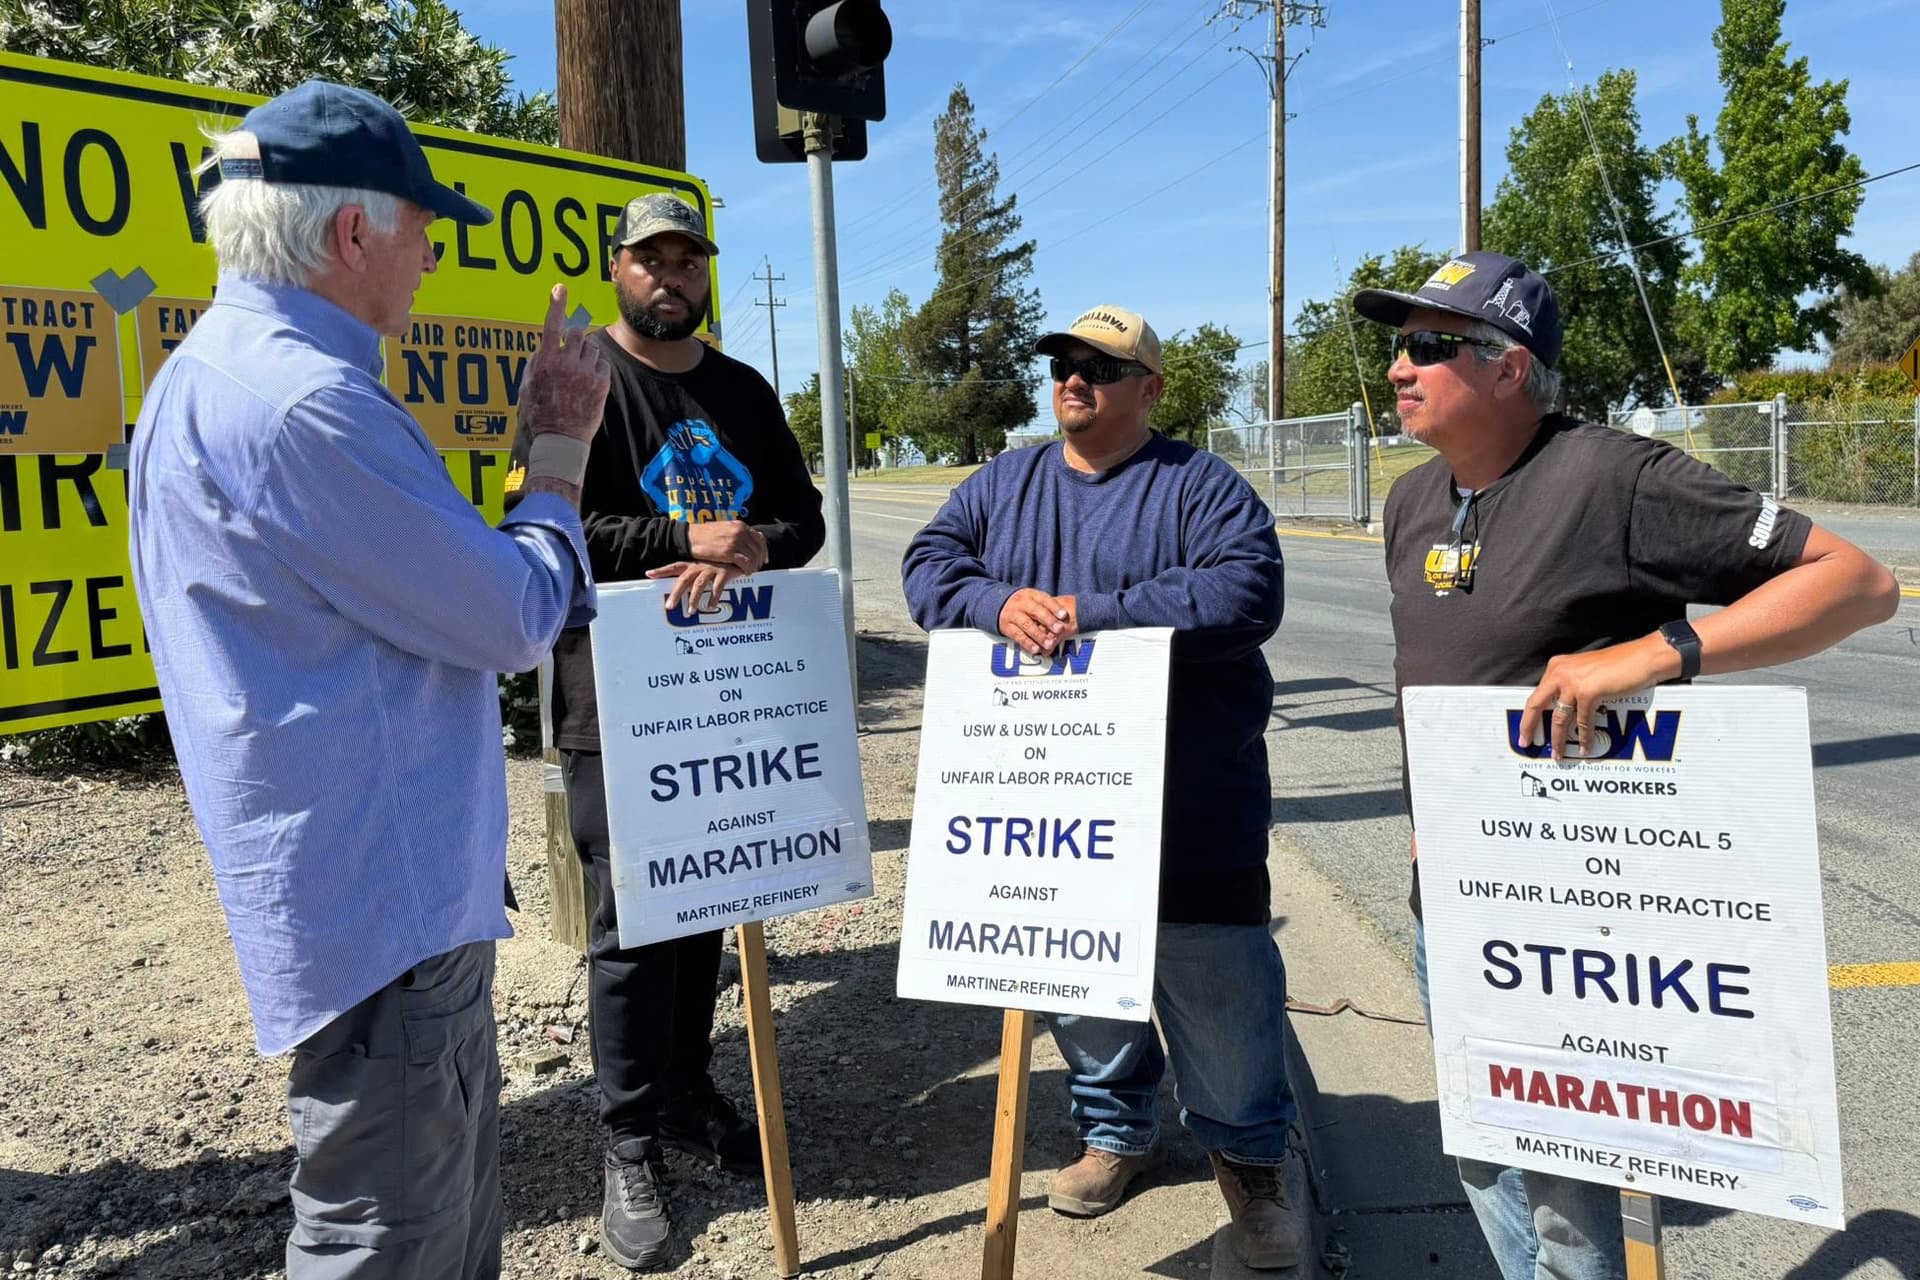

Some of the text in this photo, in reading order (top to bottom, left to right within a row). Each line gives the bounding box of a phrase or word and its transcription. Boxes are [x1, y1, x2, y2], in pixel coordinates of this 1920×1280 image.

[2, 297, 95, 330] TRACT
[158, 306, 208, 334] FAI
[6, 332, 97, 399] W
[454, 415, 508, 435] USW
[664, 474, 733, 488] EDUCATE
[666, 488, 736, 505] UNITE
[695, 631, 774, 649] OIL WORKERS
[647, 659, 806, 689] USW & USW LOCAL 5
[719, 687, 743, 703] ON
[1011, 688, 1088, 701] OIL WORKERS
[631, 699, 829, 738] UNFAIR LABOR PRACTICE
[963, 722, 1116, 738] USW & USW LOCAL 5
[1024, 746, 1047, 760] ON
[649, 742, 823, 803] STRIKE
[941, 771, 1133, 786] UNFAIR LABOR PRACTICE
[1518, 762, 1543, 770] UNITY
[1566, 764, 1611, 773] STRENGTH
[1614, 765, 1631, 773] FOR
[1635, 766, 1677, 775] WORKERS
[1550, 778, 1678, 796] OIL WORKERS
[707, 809, 776, 834] AGAINST
[1481, 819, 1732, 851] USW & USW LOCAL 5
[945, 815, 1116, 860] STRIKE
[648, 827, 842, 889] MARATHON
[1585, 856, 1621, 877] ON
[676, 898, 750, 924] MARTINEZ
[752, 883, 819, 908] REFINERY
[988, 884, 1059, 902] AGAINST
[1459, 879, 1772, 922] UNFAIR LABOR PRACTICE
[928, 919, 1121, 963] MARATHON
[946, 974, 1090, 1000] MARTINEZ REFINERY
[1482, 939, 1755, 1019] STRIKE
[1560, 1033, 1669, 1064] AGAINST
[1488, 1063, 1753, 1139] MARATHON
[1515, 1135, 1739, 1191] MARTINEZ REFINERY
